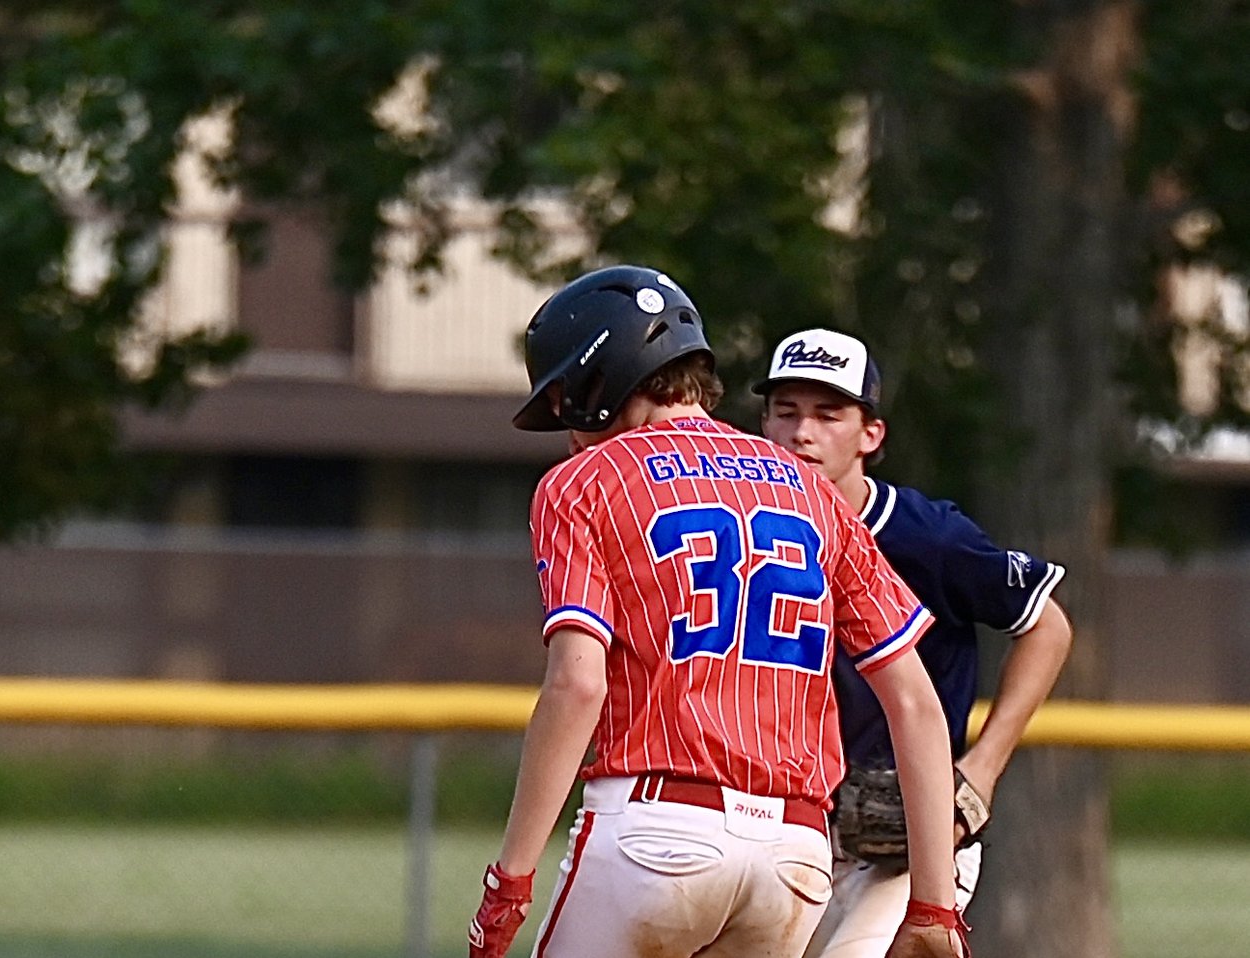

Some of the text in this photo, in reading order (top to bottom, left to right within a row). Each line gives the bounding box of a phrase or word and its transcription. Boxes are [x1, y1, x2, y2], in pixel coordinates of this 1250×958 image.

[778, 339, 850, 372] Padres
[644, 451, 805, 493] GLASSER
[646, 502, 828, 677] 32
[734, 802, 775, 819] RIVAL
